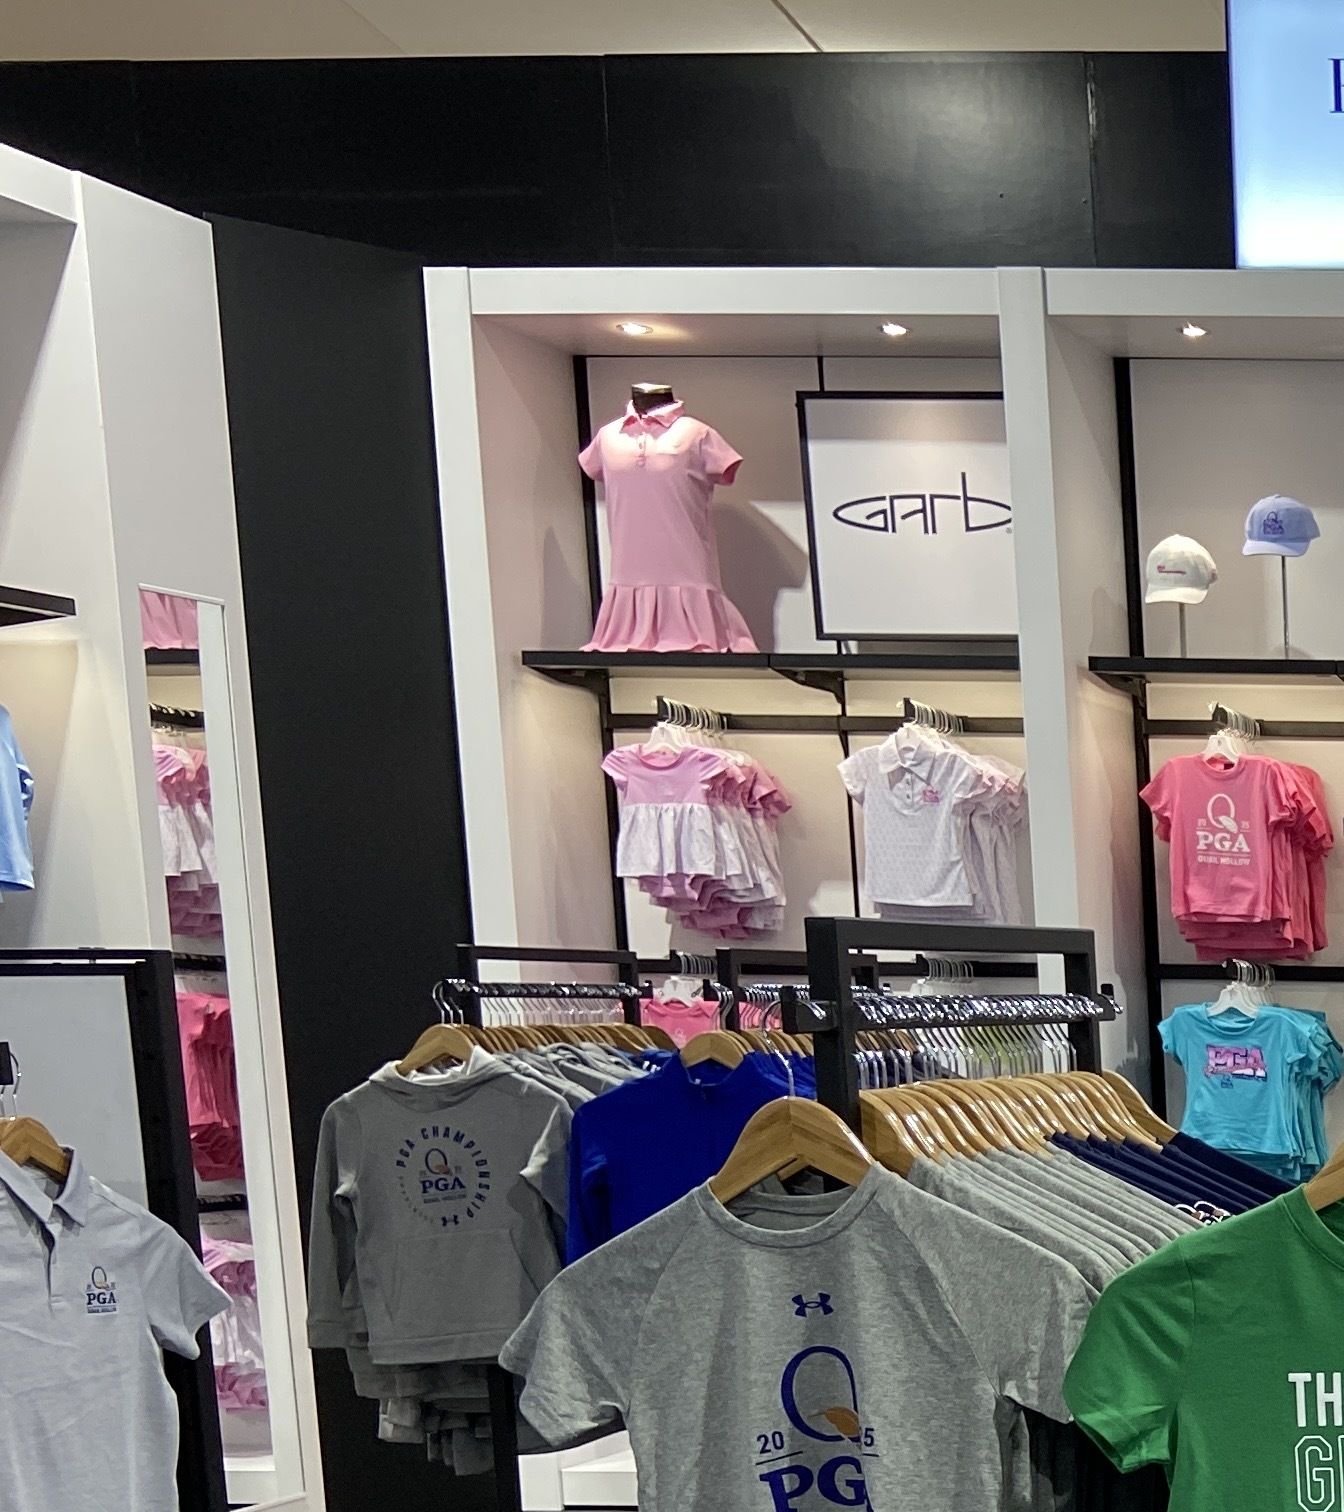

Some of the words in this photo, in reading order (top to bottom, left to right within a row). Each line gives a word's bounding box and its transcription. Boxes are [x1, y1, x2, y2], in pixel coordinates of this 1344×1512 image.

[1196, 831, 1251, 852] PGA
[396, 1139, 415, 1168] PGA
[421, 1126, 490, 1218] CHAMPIONSHIP
[420, 1176, 466, 1193] PGA
[86, 1292, 116, 1305] PGA
[757, 1430, 785, 1454] 20
[863, 1427, 875, 1447] 5
